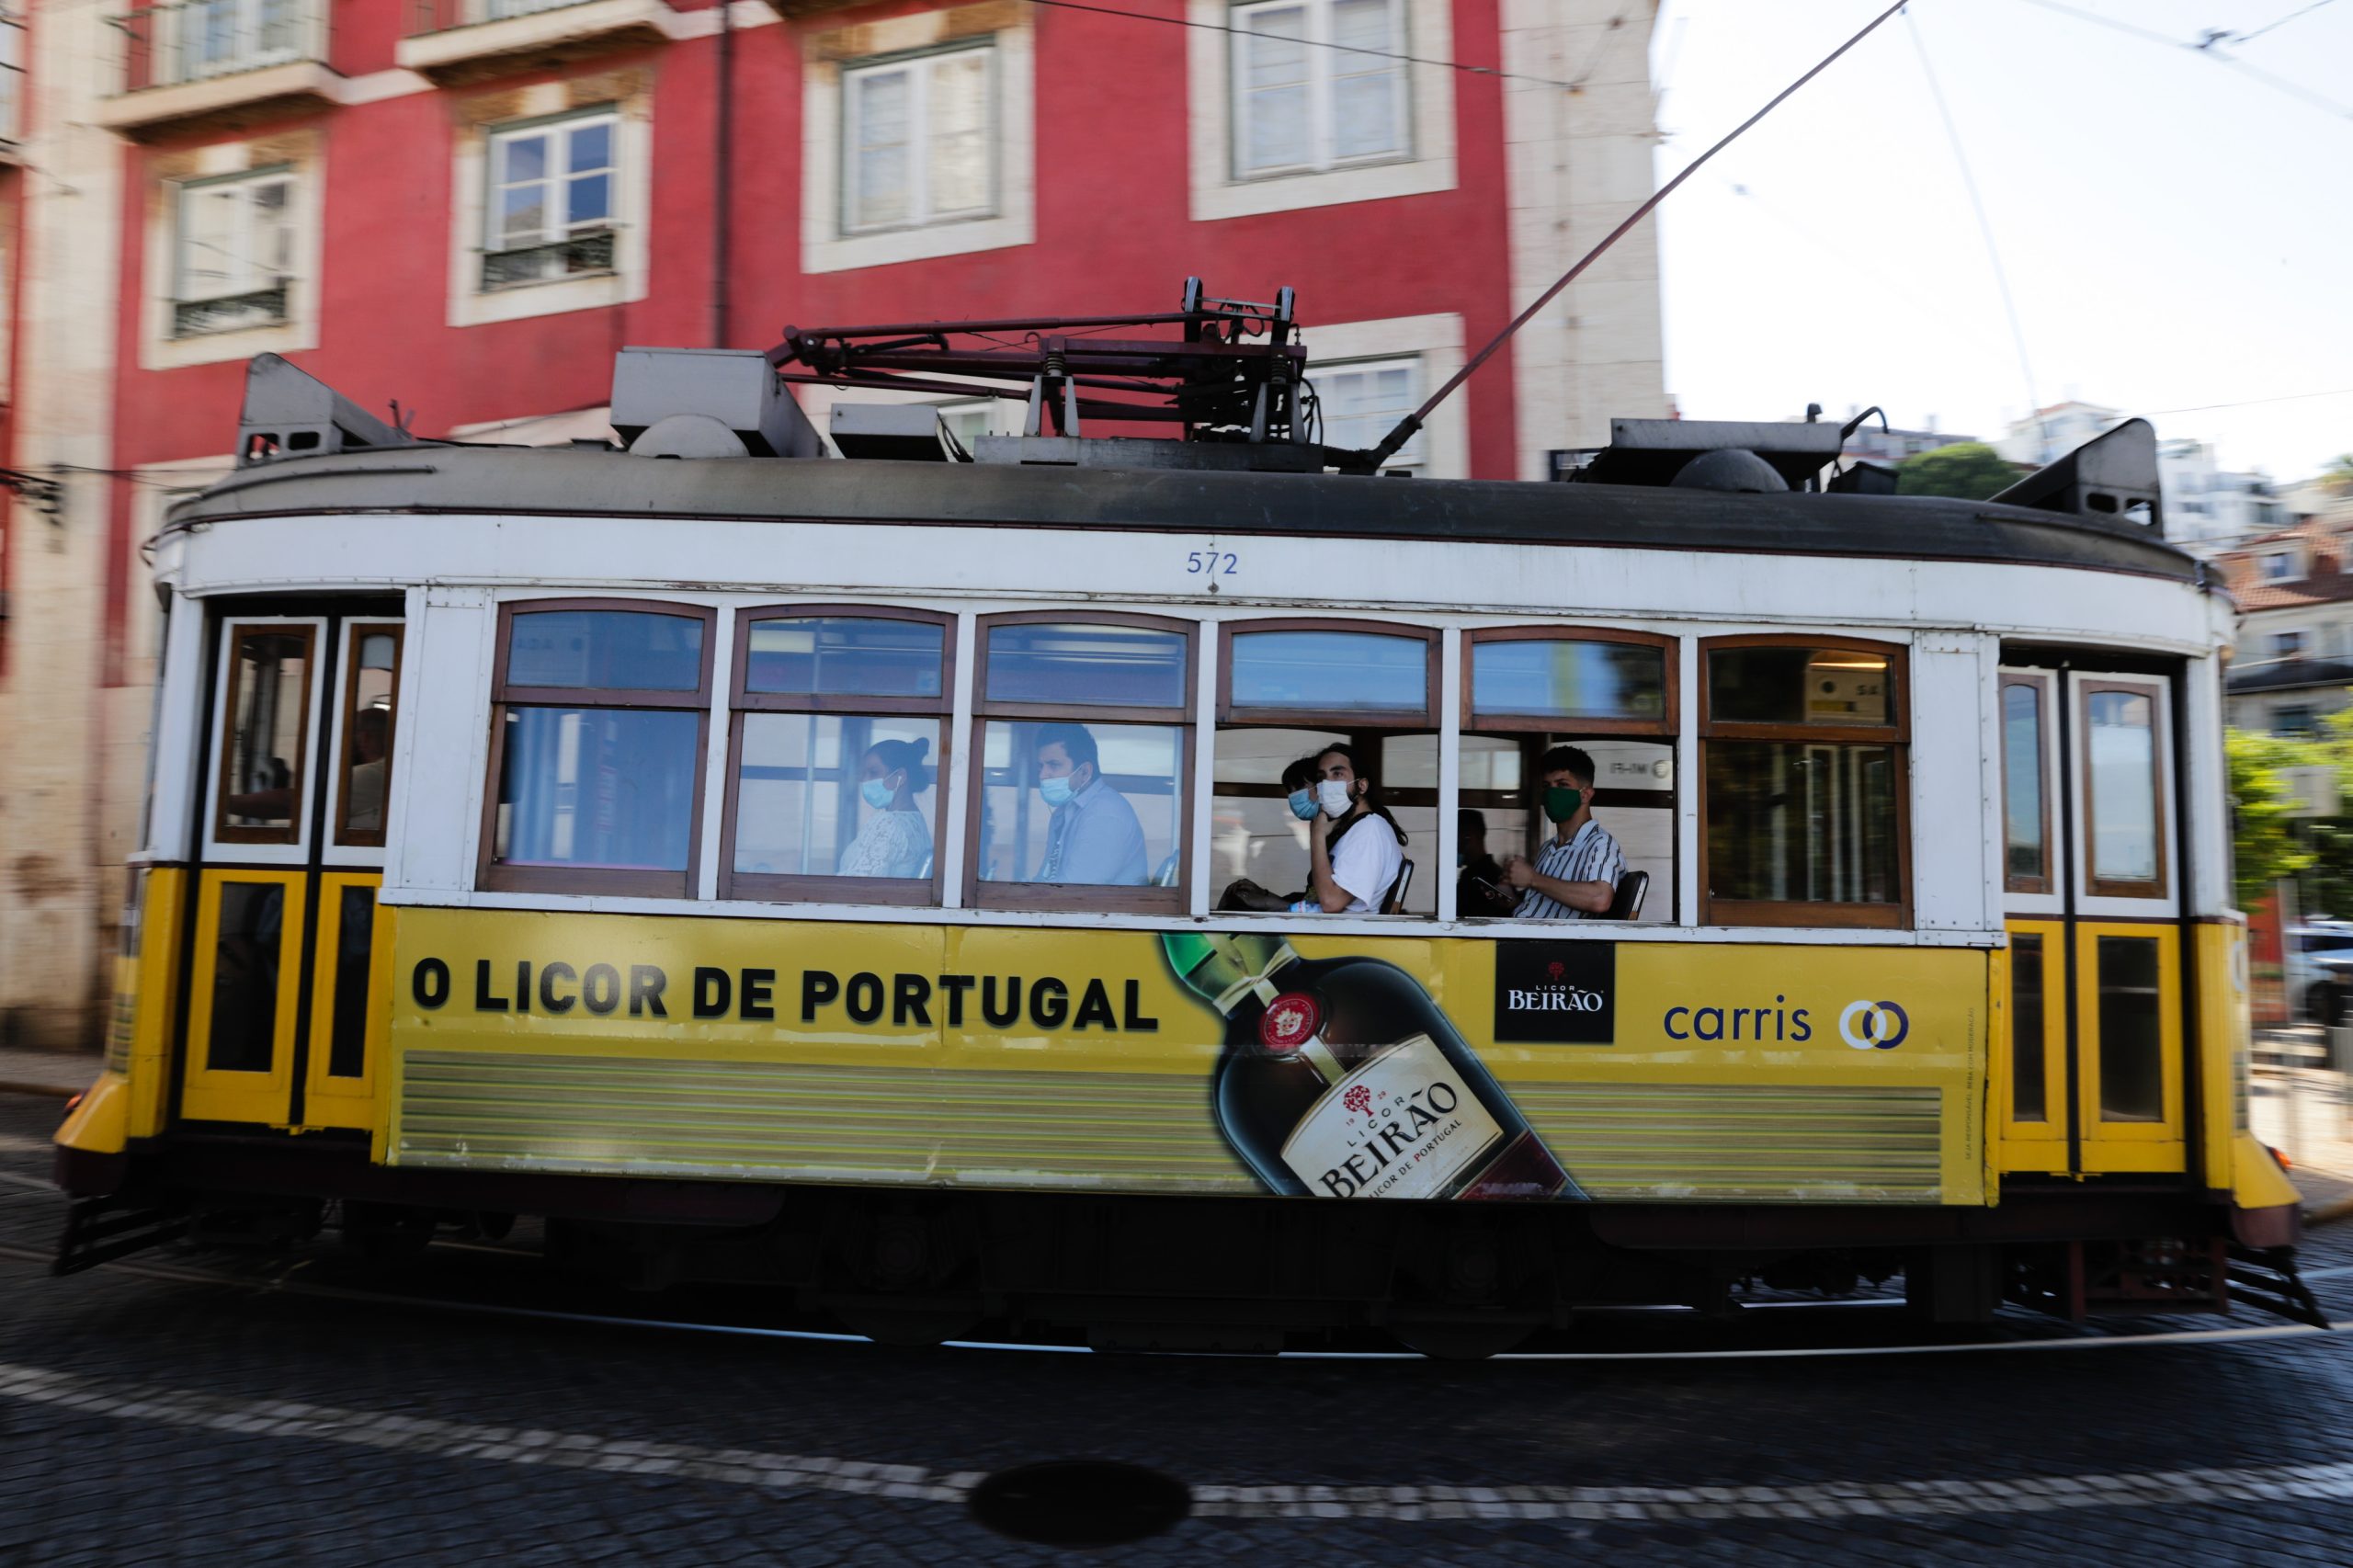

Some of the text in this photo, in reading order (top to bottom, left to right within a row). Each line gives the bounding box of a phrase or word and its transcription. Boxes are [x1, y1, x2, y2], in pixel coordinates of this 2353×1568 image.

[1187, 552, 1237, 574] 572
[412, 957, 1159, 1032] O LICOR DE PORTUGAL
[1507, 989, 1603, 1012] BEIRÃO
[1664, 994, 1812, 1041] carris
[1318, 1082, 1457, 1198] BEIRÃO
[1347, 1096, 1405, 1147] LICOR
[1398, 1161, 1414, 1176] DE
[1414, 1119, 1462, 1163] PORTUGAL
